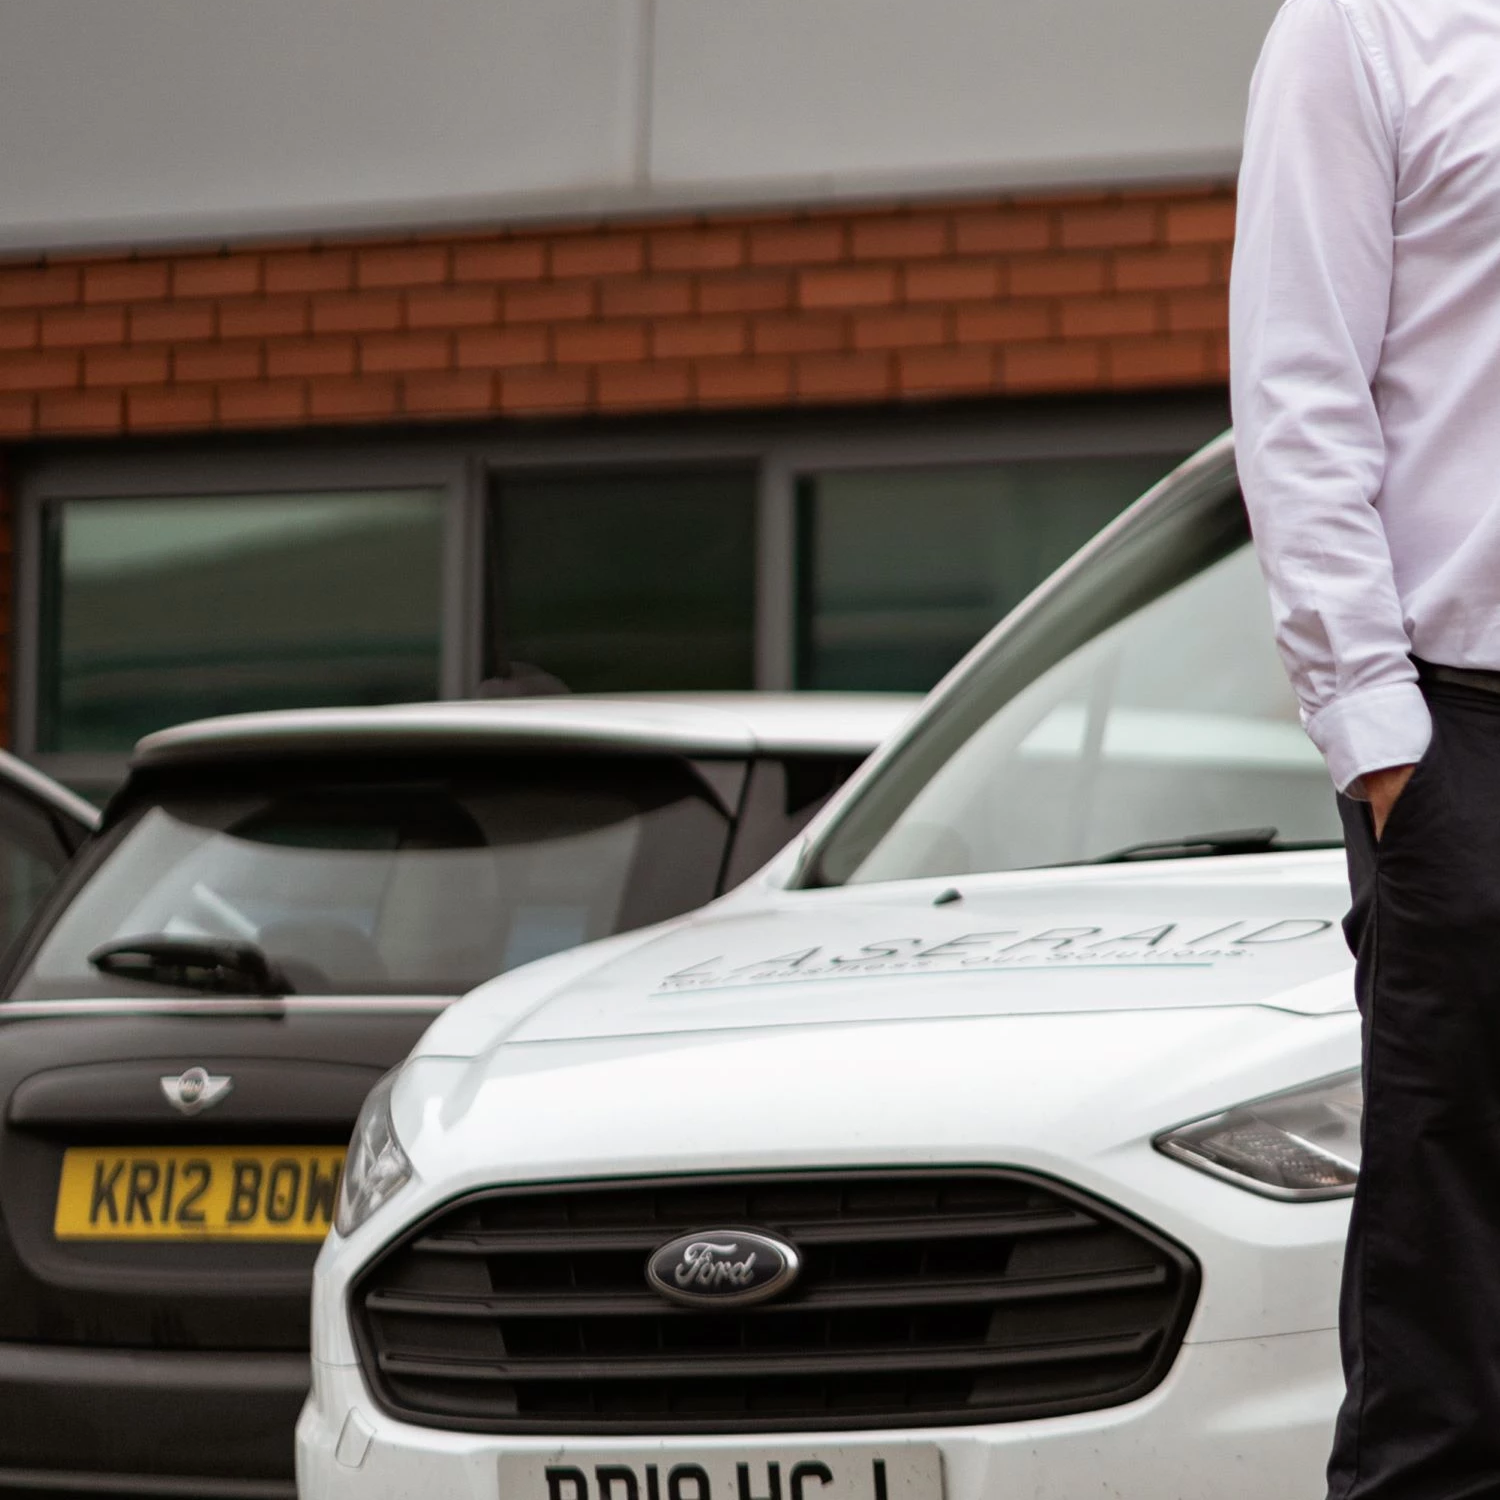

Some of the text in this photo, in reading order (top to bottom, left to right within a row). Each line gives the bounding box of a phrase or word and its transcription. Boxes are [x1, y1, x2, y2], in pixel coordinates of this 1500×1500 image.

[664, 919, 1334, 980] LASERAID
[88, 1158, 213, 1228] KR12
[675, 1242, 756, 1287] Ford
